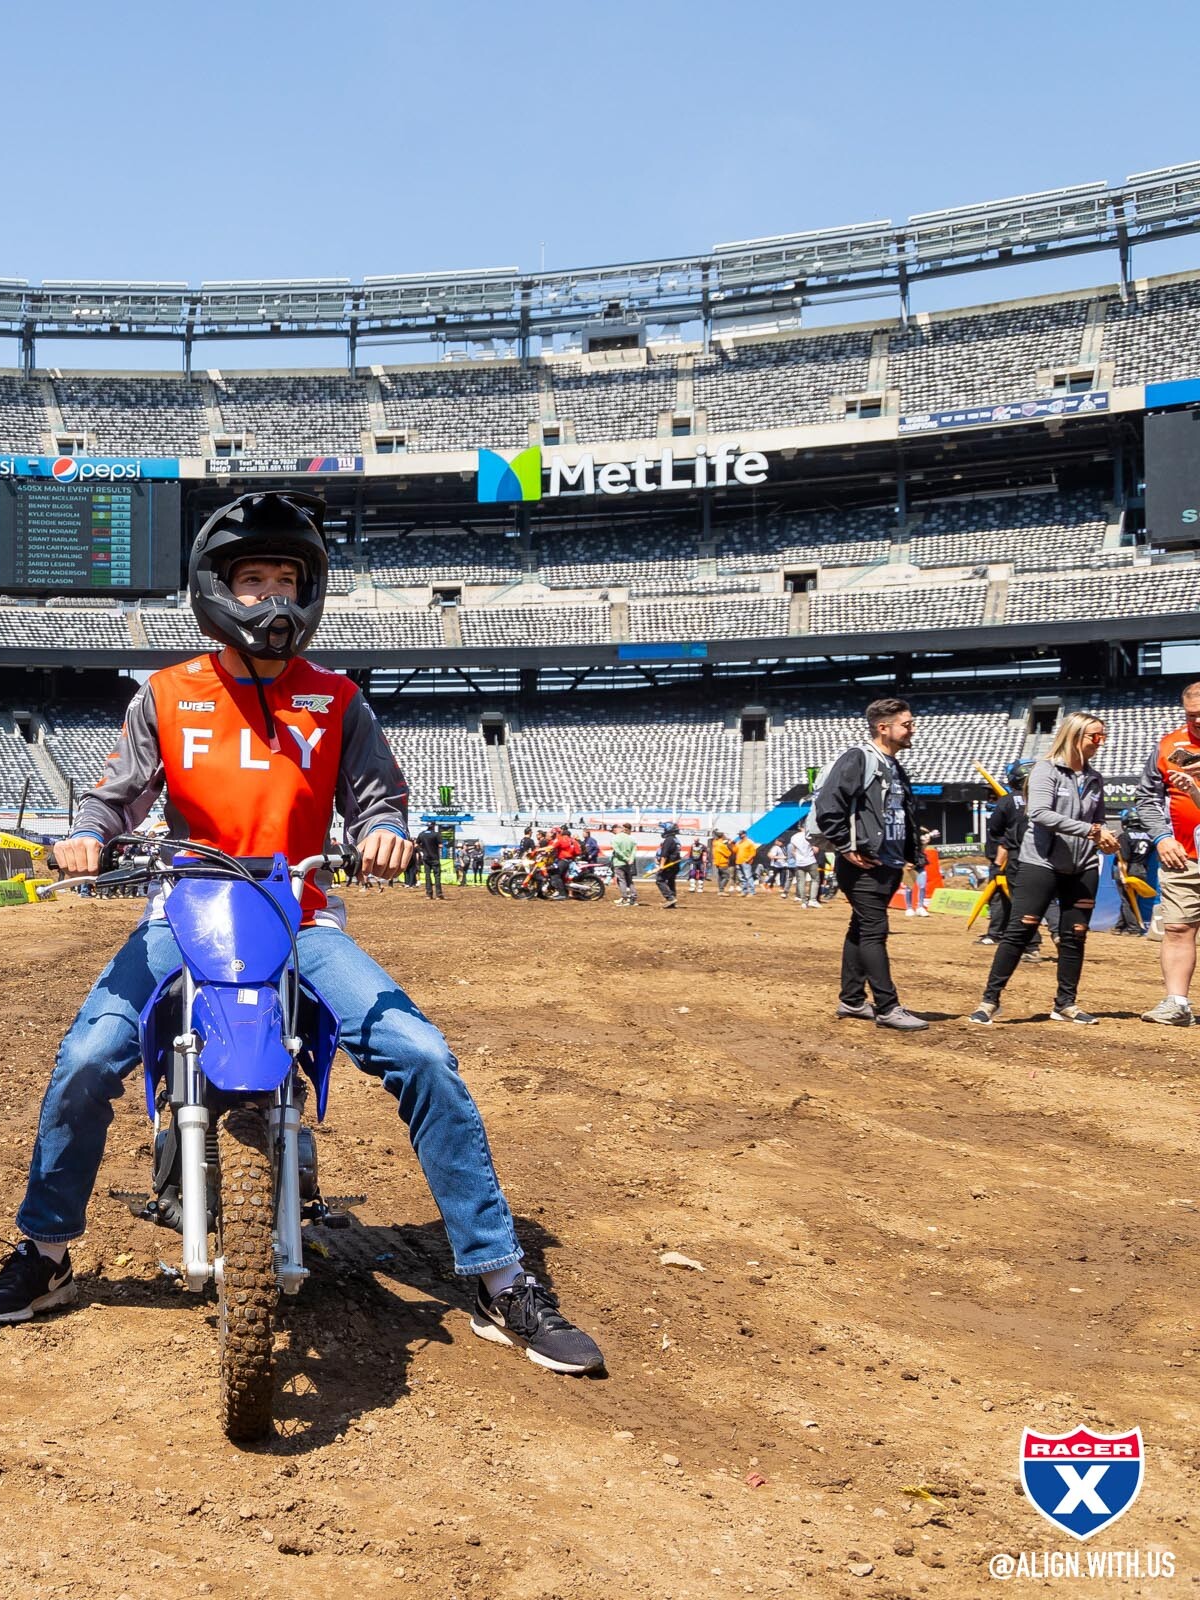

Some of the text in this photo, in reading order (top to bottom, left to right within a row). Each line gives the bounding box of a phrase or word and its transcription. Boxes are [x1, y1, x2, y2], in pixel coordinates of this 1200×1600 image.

[79, 460, 141, 482] pepsi
[549, 441, 769, 497] MetLife
[96, 486, 132, 494] RESULTS
